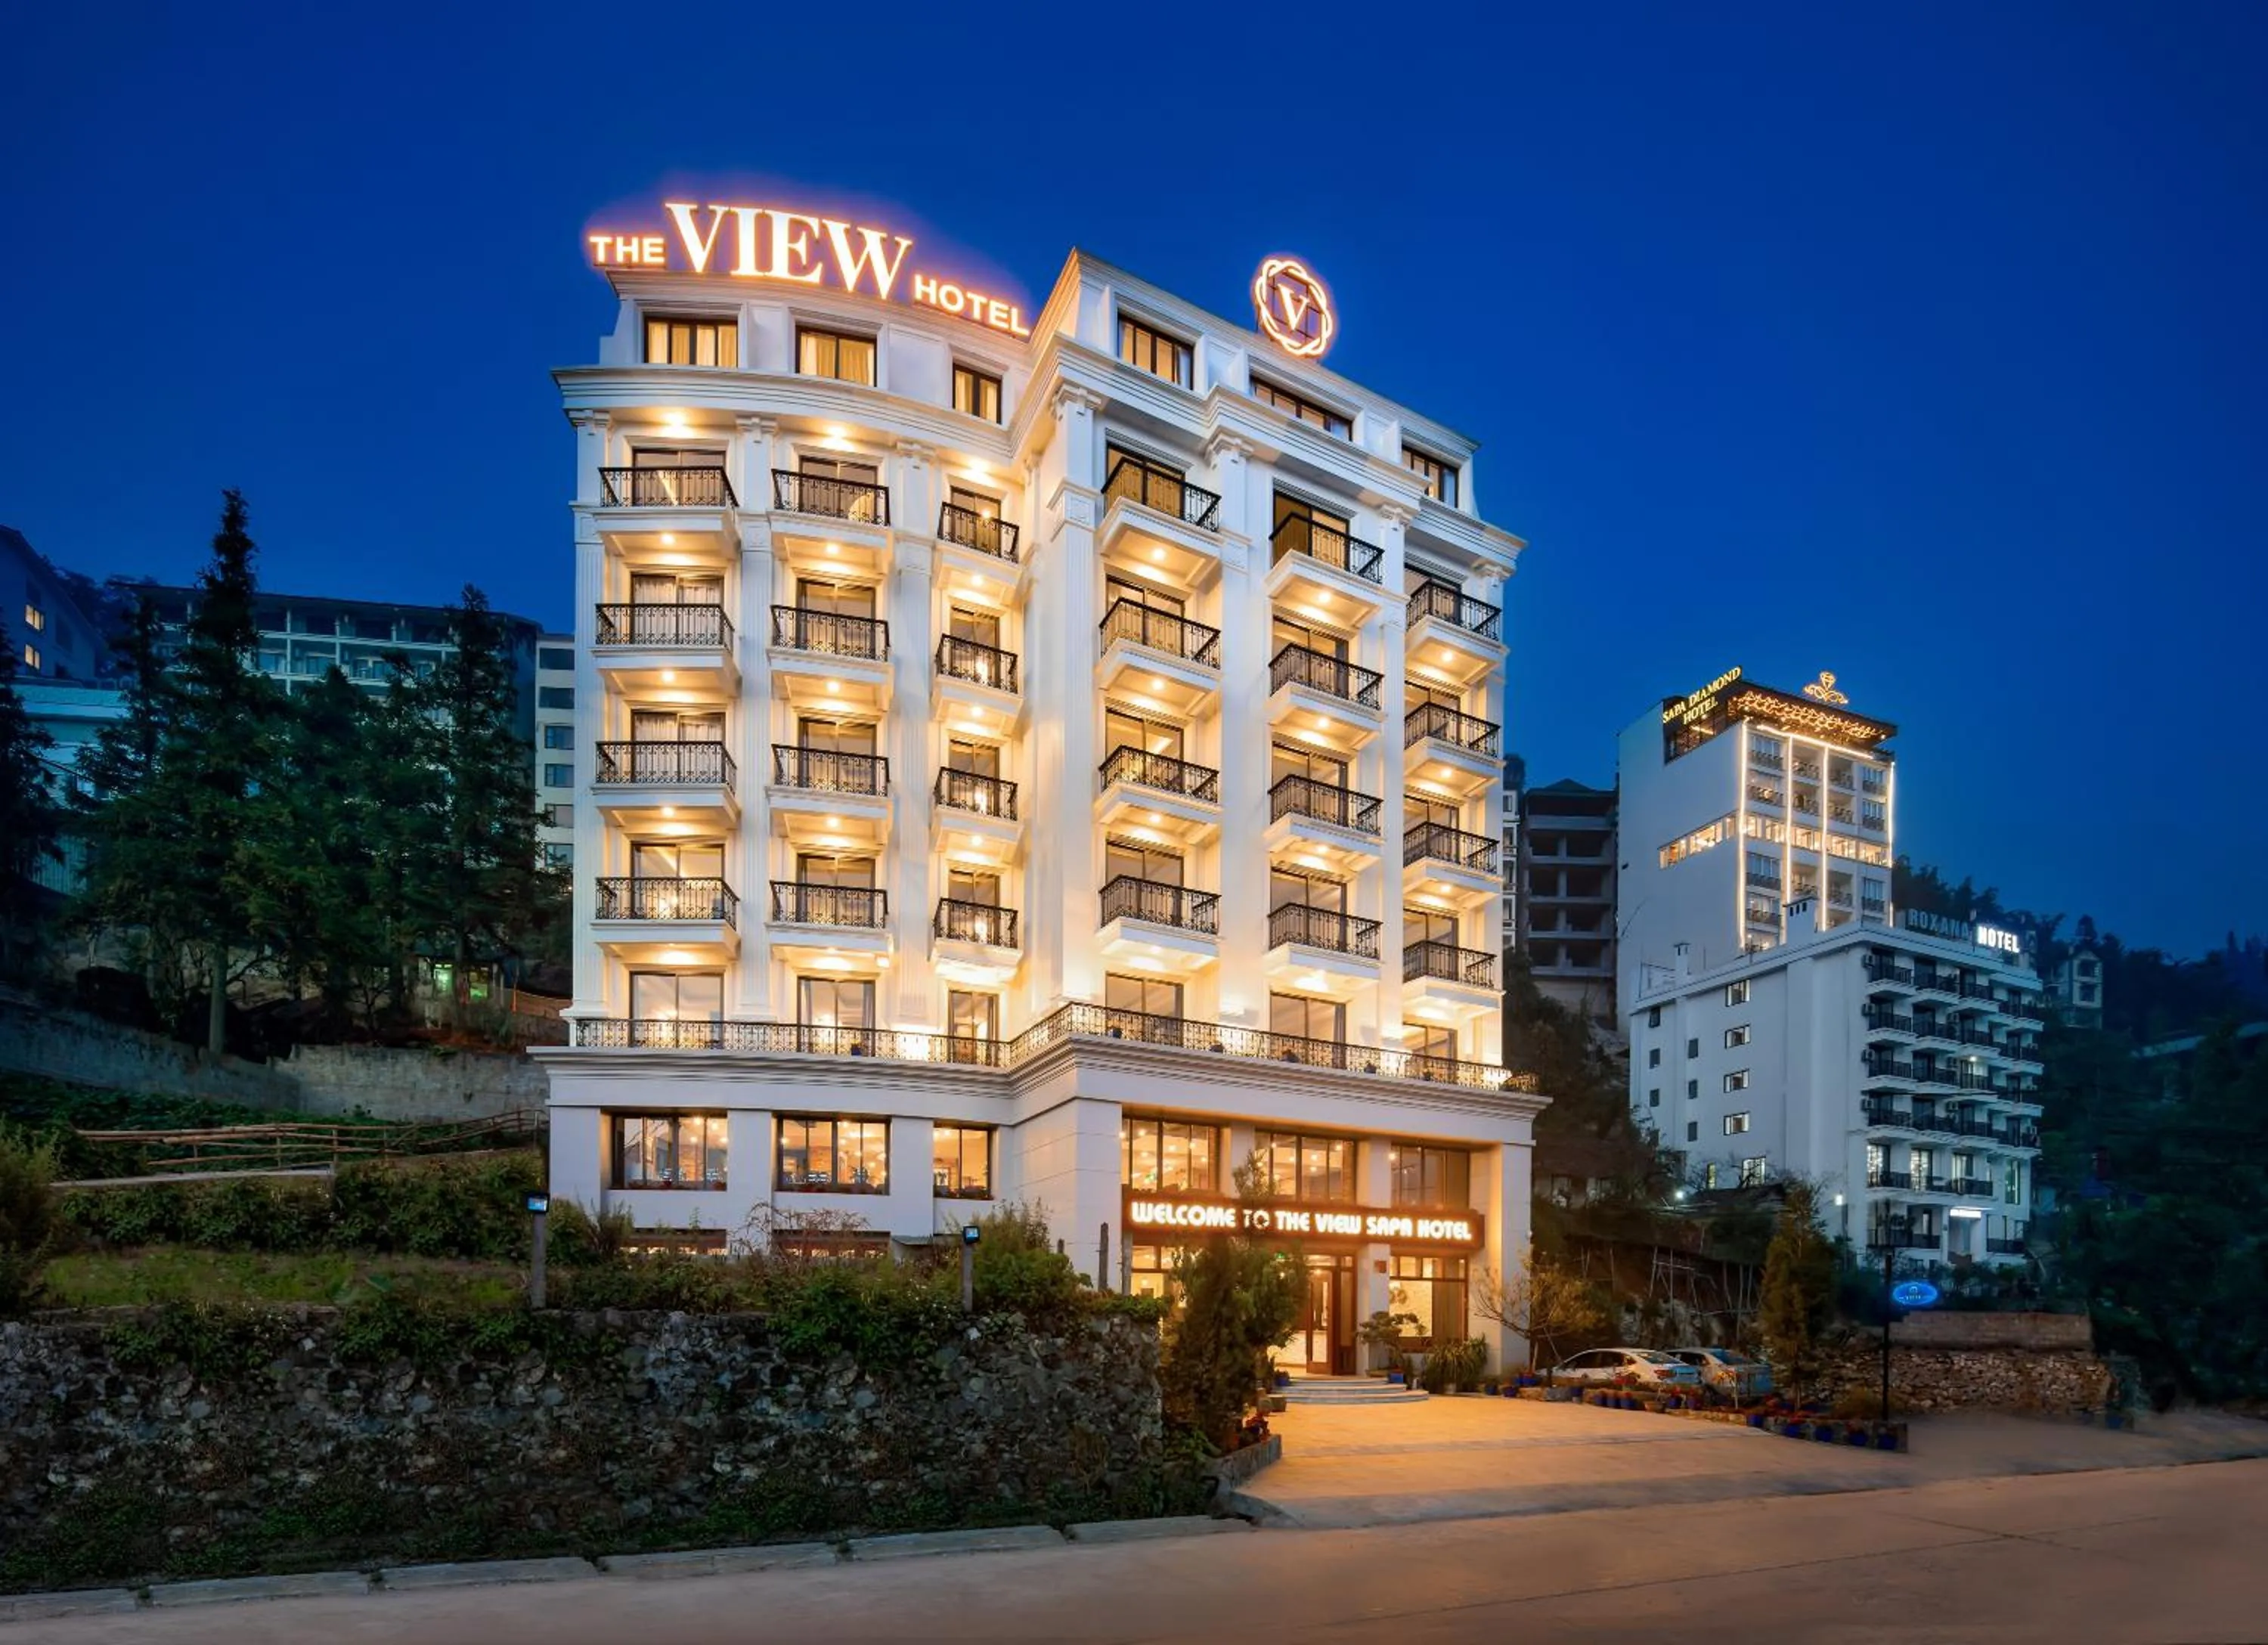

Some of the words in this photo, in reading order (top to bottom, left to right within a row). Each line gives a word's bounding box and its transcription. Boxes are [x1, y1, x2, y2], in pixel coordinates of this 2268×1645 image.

[589, 235, 665, 263] THE
[665, 203, 912, 299] VIEW
[914, 273, 1030, 336] HOTEL
[1278, 283, 1309, 330] V
[1662, 701, 1687, 723] SAPA
[1688, 667, 1741, 706] DIAMOND
[1683, 696, 1718, 724] HOTEL
[1908, 909, 1969, 938] ROXANA
[1978, 925, 2020, 953] HOTEL
[1132, 1201, 1236, 1228] WELCOME
[1243, 1209, 1269, 1228] TO
[1275, 1210, 1310, 1231] THE
[1315, 1213, 1361, 1235] VIEW
[1366, 1216, 1412, 1237] SAPA
[1417, 1218, 1472, 1241] HOTEL
